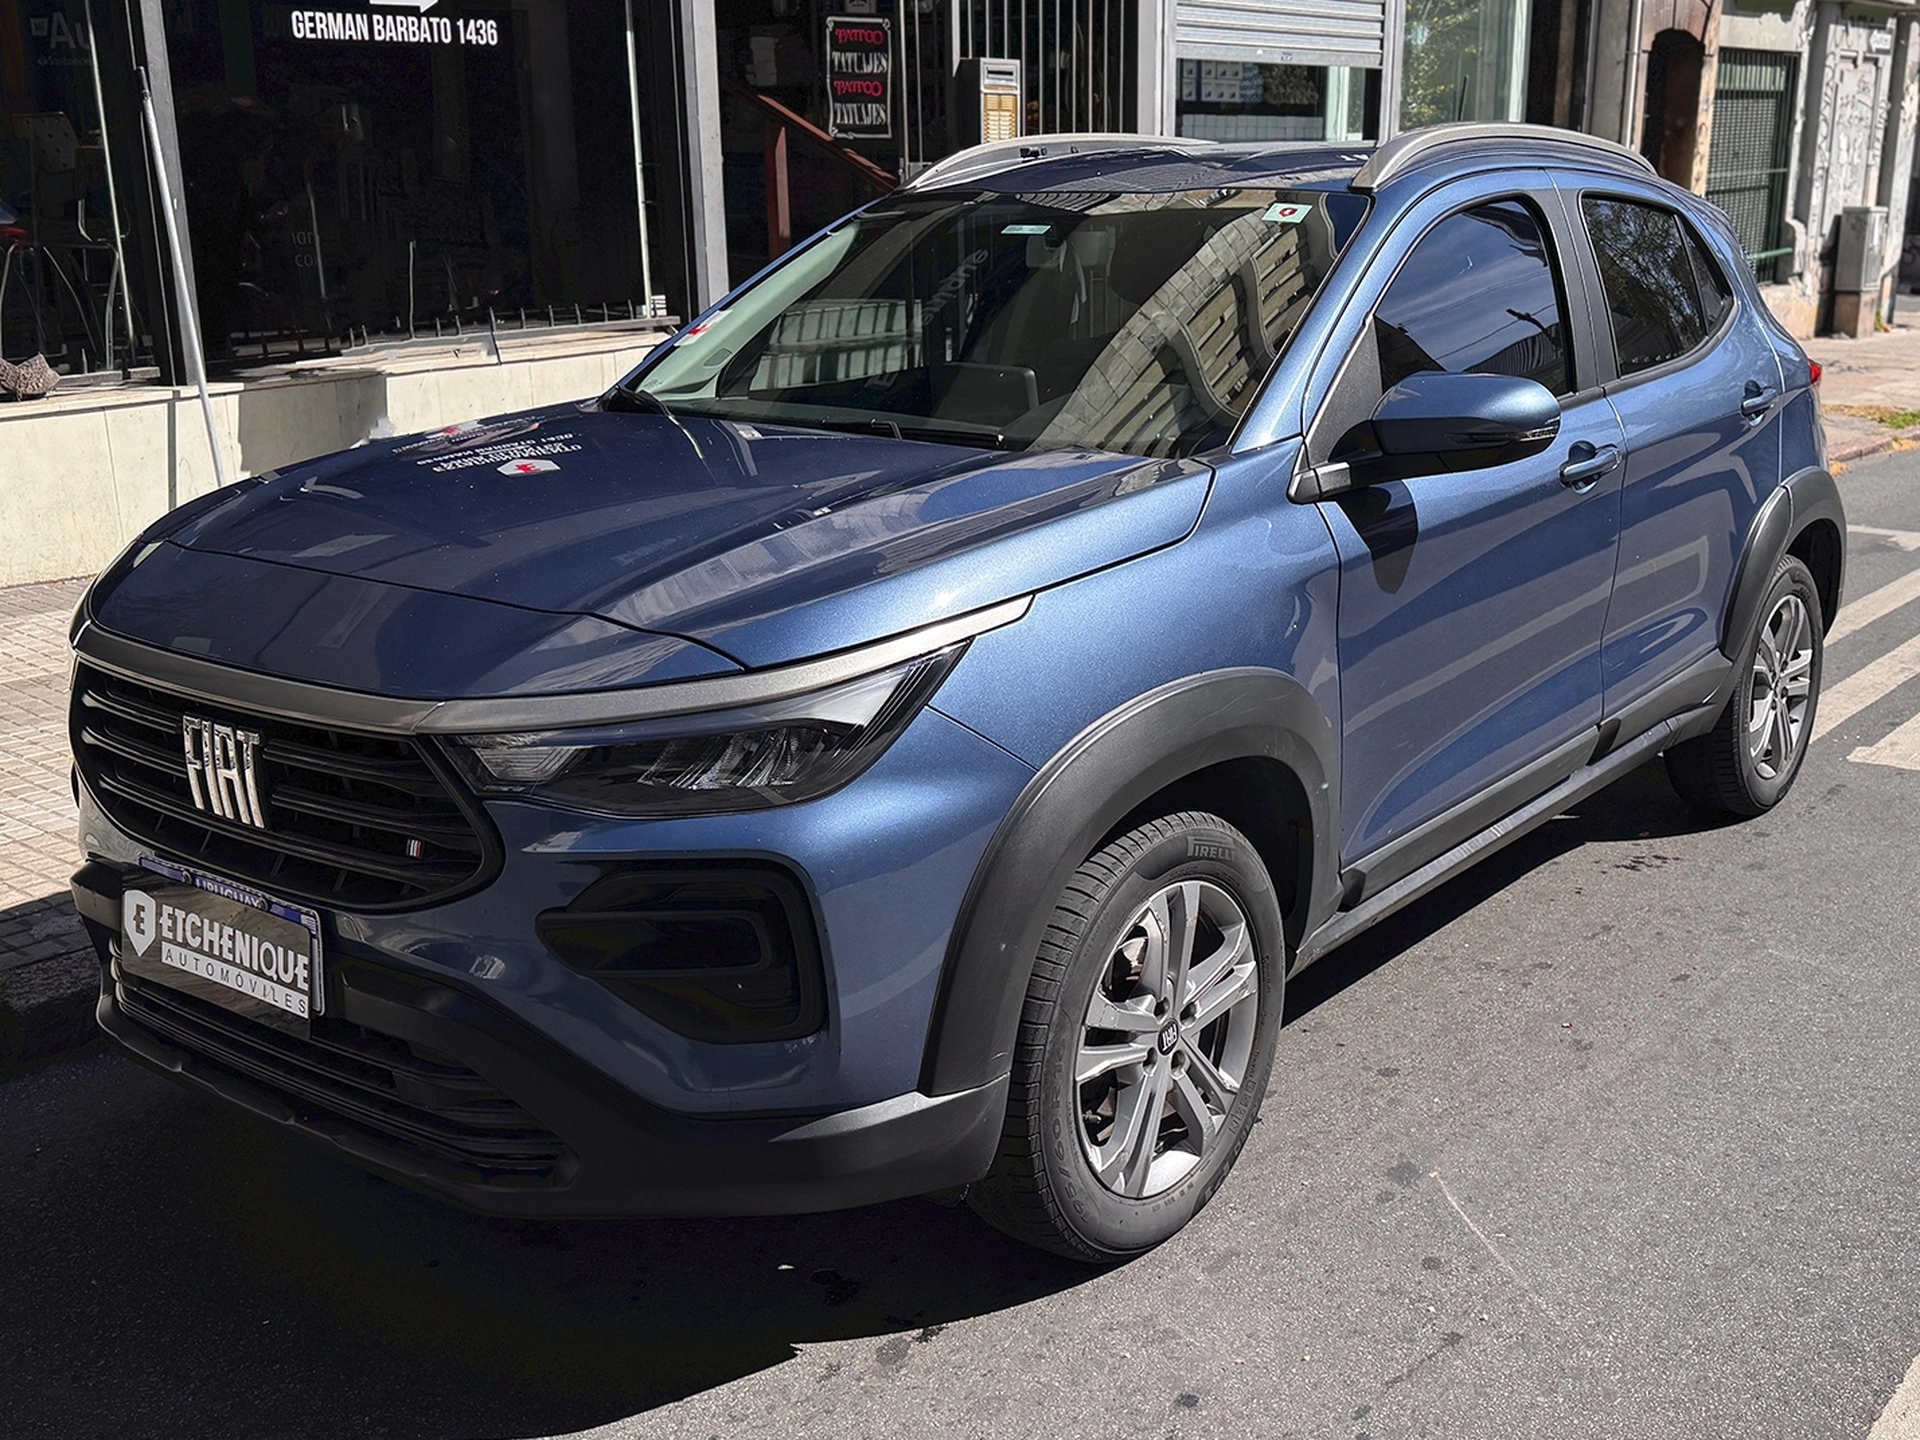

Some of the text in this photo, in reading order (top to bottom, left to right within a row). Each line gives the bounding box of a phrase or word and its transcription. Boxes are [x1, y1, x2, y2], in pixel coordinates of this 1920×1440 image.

[291, 11, 498, 45] GERMAN BARBATO 1436
[832, 51, 888, 73] TATUAJES
[834, 103, 887, 125] TATUAJES
[182, 715, 265, 829] FIAT
[1186, 836, 1236, 861] PIRELLI
[159, 904, 309, 992] ETCHENIQUE
[165, 948, 307, 1015] AUTOMÓVILES
